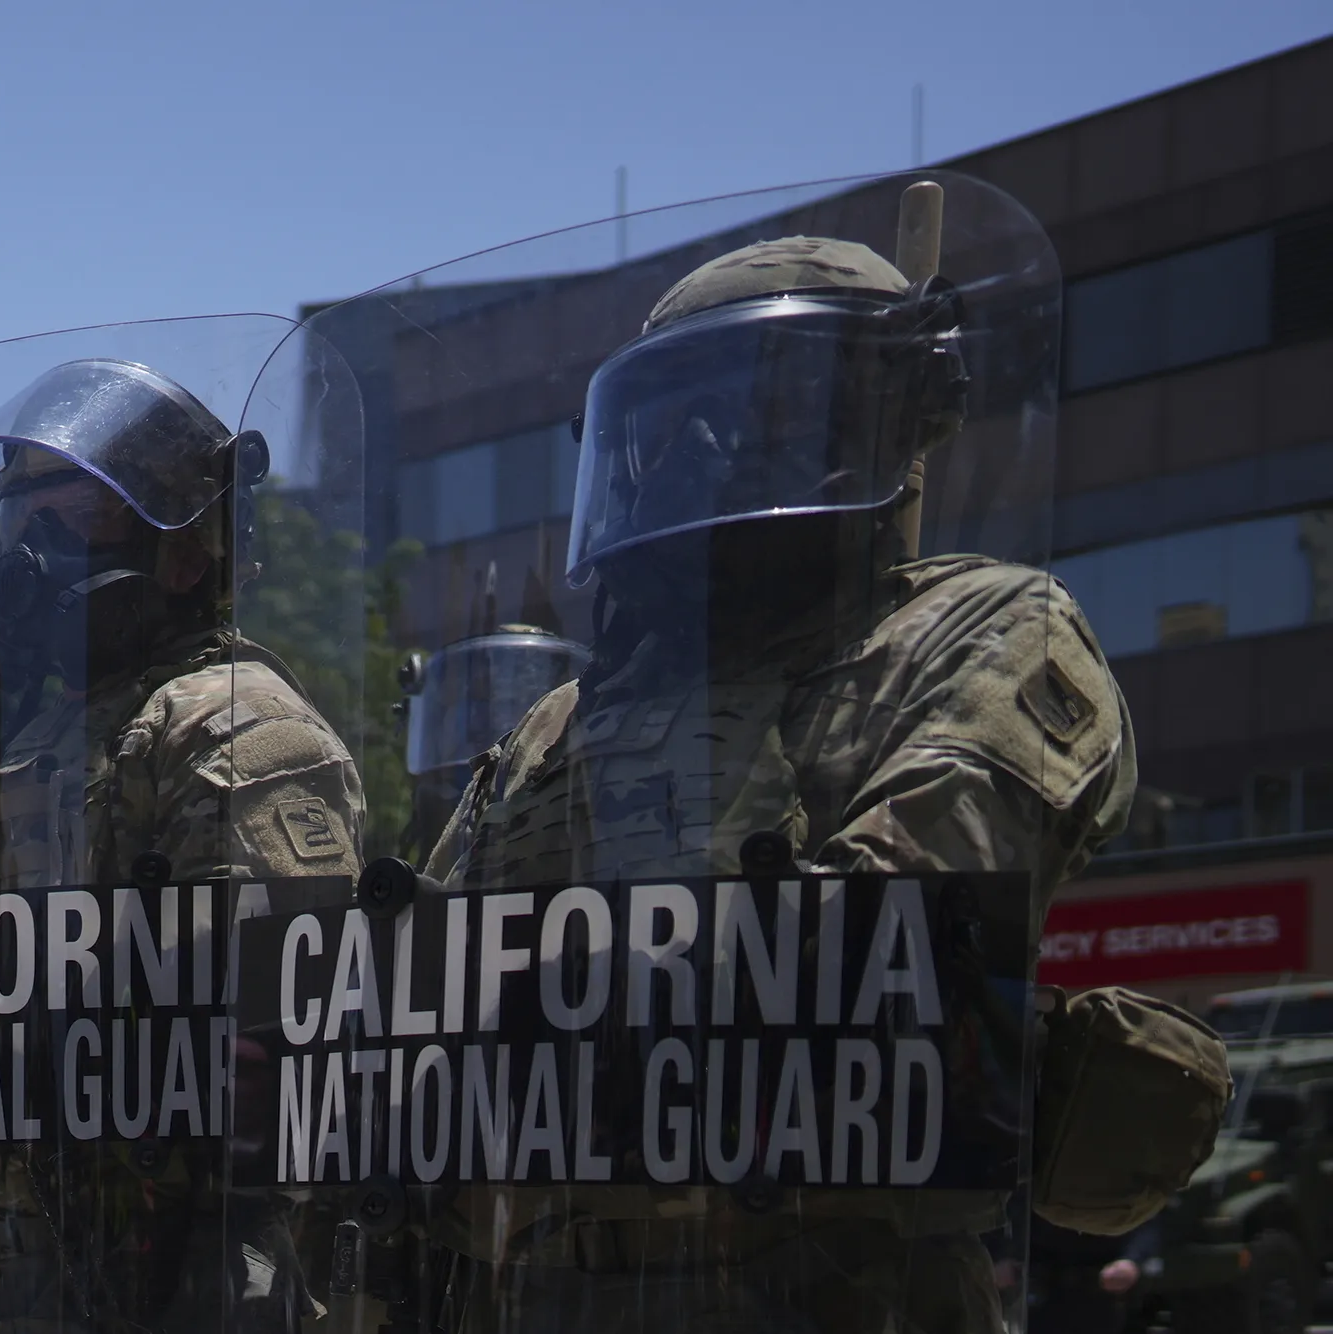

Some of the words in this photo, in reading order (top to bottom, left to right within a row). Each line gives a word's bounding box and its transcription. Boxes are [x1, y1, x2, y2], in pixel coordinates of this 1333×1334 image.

[279, 878, 944, 1046] CALIFORNIA
[1102, 913, 1280, 958] SERVICES
[63, 1016, 237, 1141] GUAR
[277, 1040, 612, 1184] NATIONAL
[642, 1037, 945, 1186] GUARD
